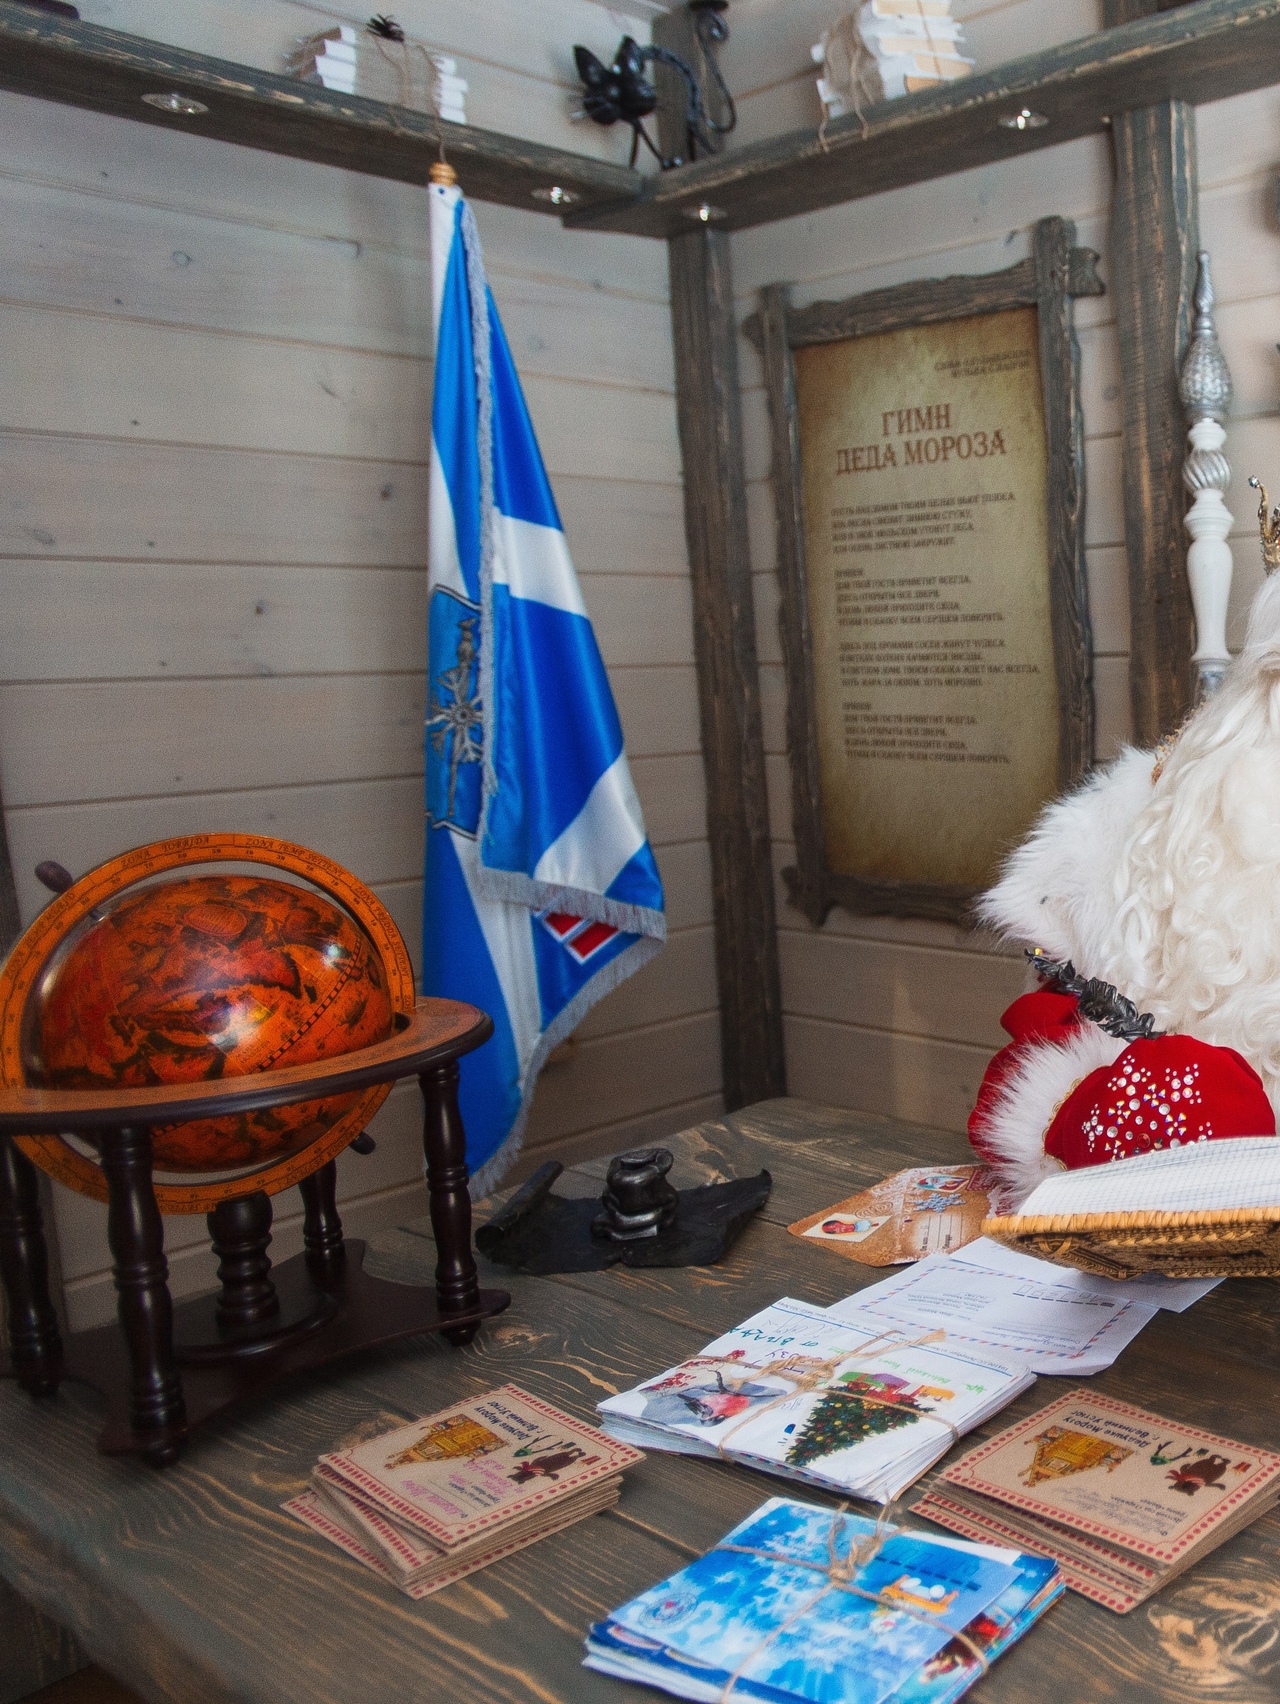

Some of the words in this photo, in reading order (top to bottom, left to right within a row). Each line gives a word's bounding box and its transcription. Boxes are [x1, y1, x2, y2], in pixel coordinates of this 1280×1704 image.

[881, 403, 953, 437] ГИМН
[836, 443, 898, 476] ДЕДА
[904, 428, 1008, 467] МОРОЗА
[120, 849, 150, 867] ZONA
[245, 837, 273, 848] ZONA
[278, 842, 304, 857] TEMP
[305, 852, 345, 878] SETTENT
[354, 884, 376, 906] ZONA
[1063, 1416, 1103, 1433] Морозу
[1070, 1410, 1104, 1424] Устюг
[1103, 1420, 1150, 1439] Великий
[1103, 1430, 1151, 1449] Дедушке
